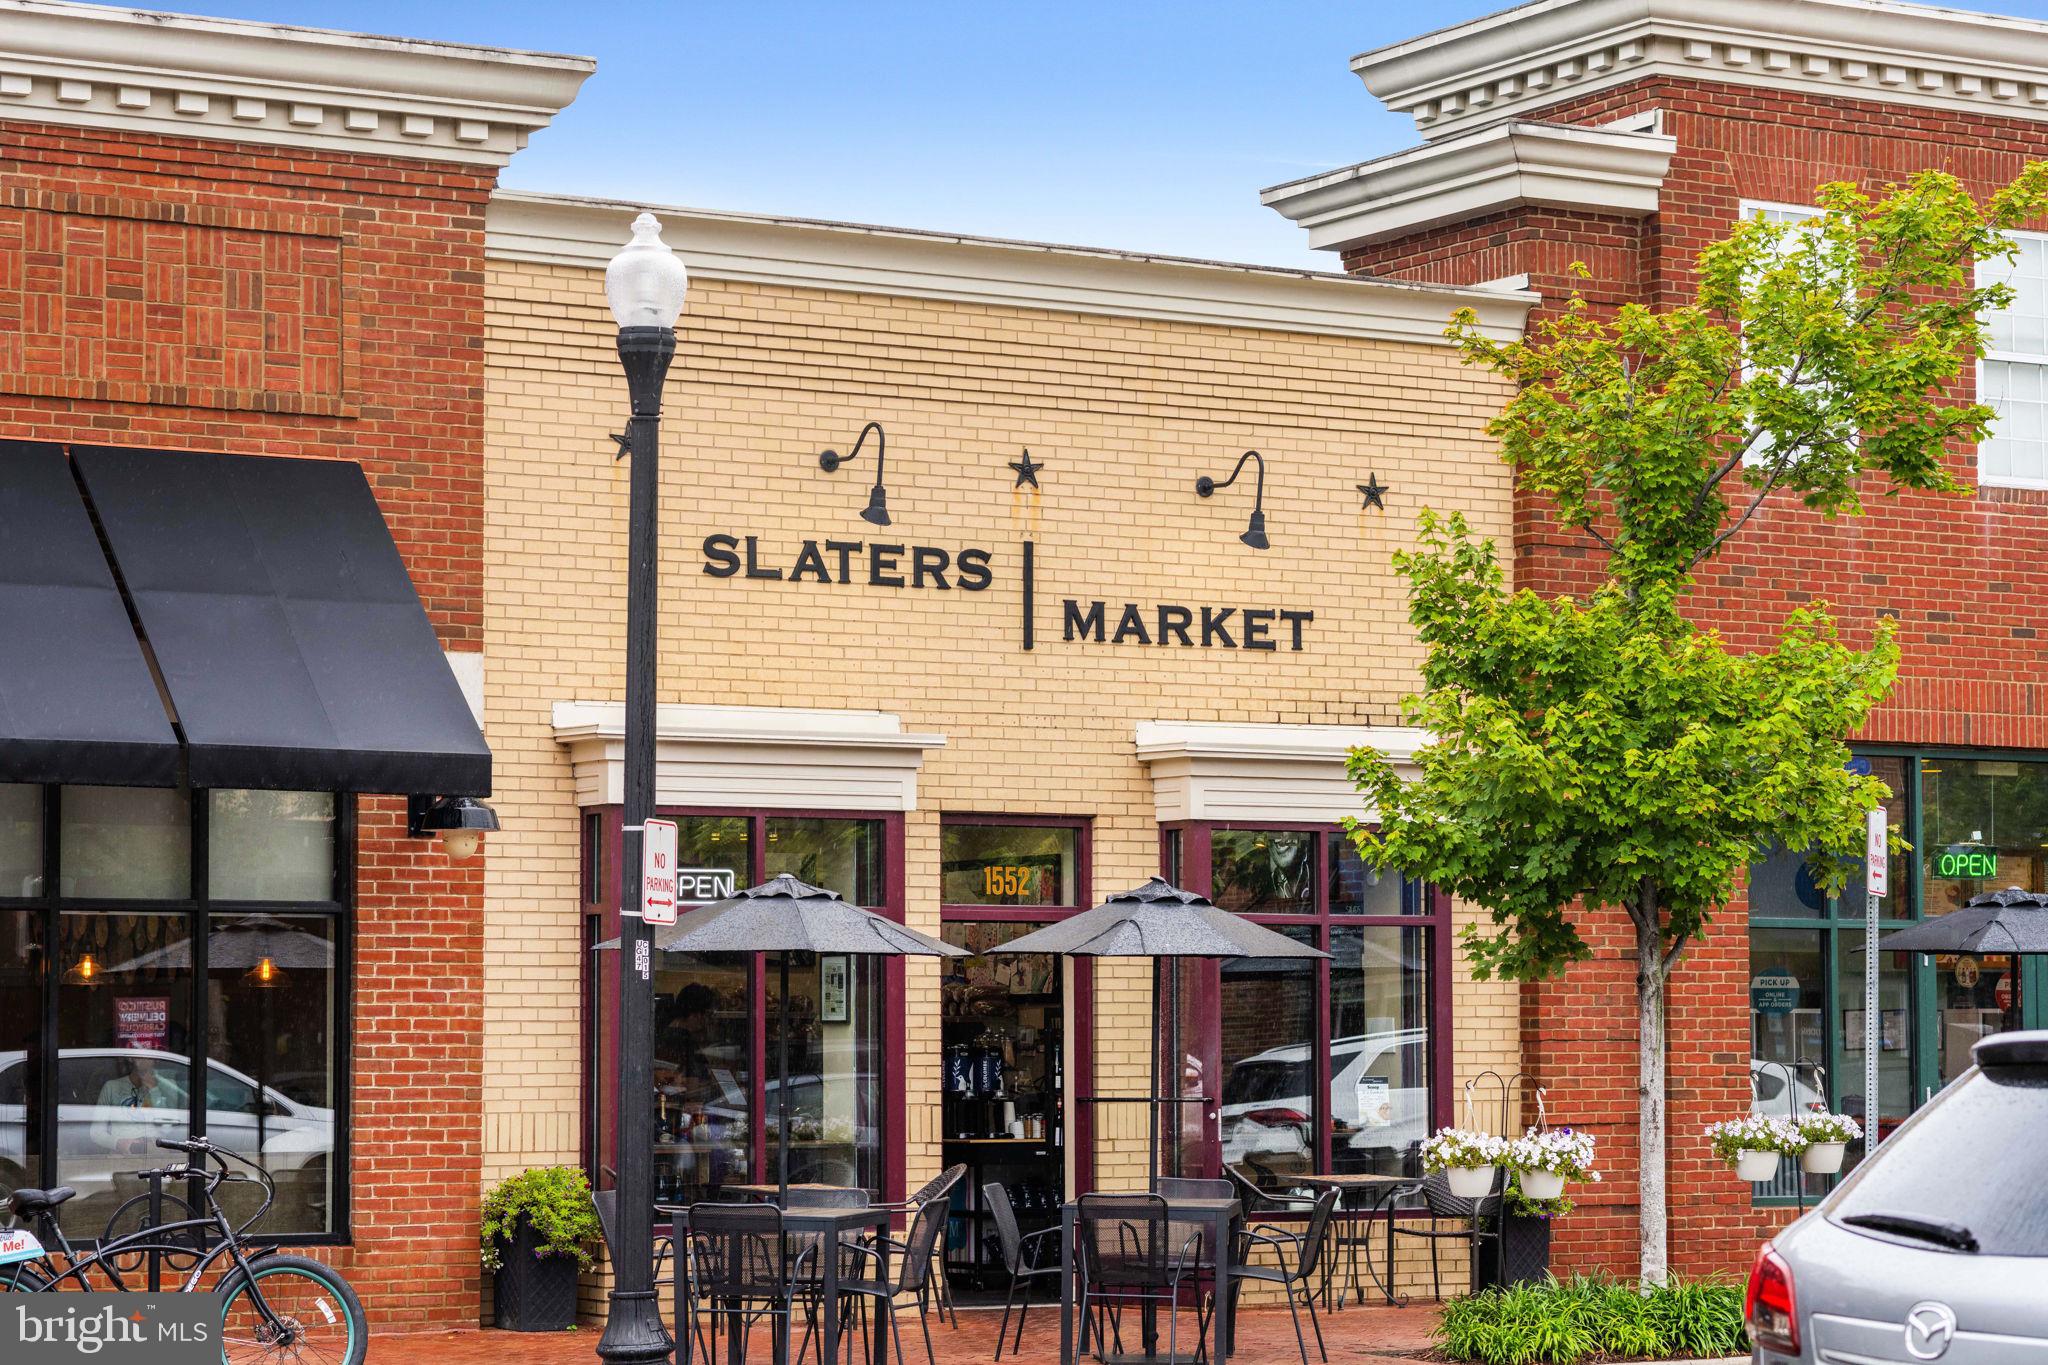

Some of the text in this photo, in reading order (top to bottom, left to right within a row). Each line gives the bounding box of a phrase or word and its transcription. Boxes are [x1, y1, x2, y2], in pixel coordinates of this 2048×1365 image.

[702, 533, 993, 591] SLATERS
[1062, 599, 1314, 651] MARKET
[1874, 833, 1881, 848] NO
[654, 853, 666, 869] NO
[1870, 853, 1886, 869] PARKING
[1941, 854, 1997, 876] OPEN
[646, 876, 674, 893] PARKING
[677, 875, 731, 898] PEN
[983, 866, 1030, 896] 1552
[3, 1239, 25, 1252] Me!
